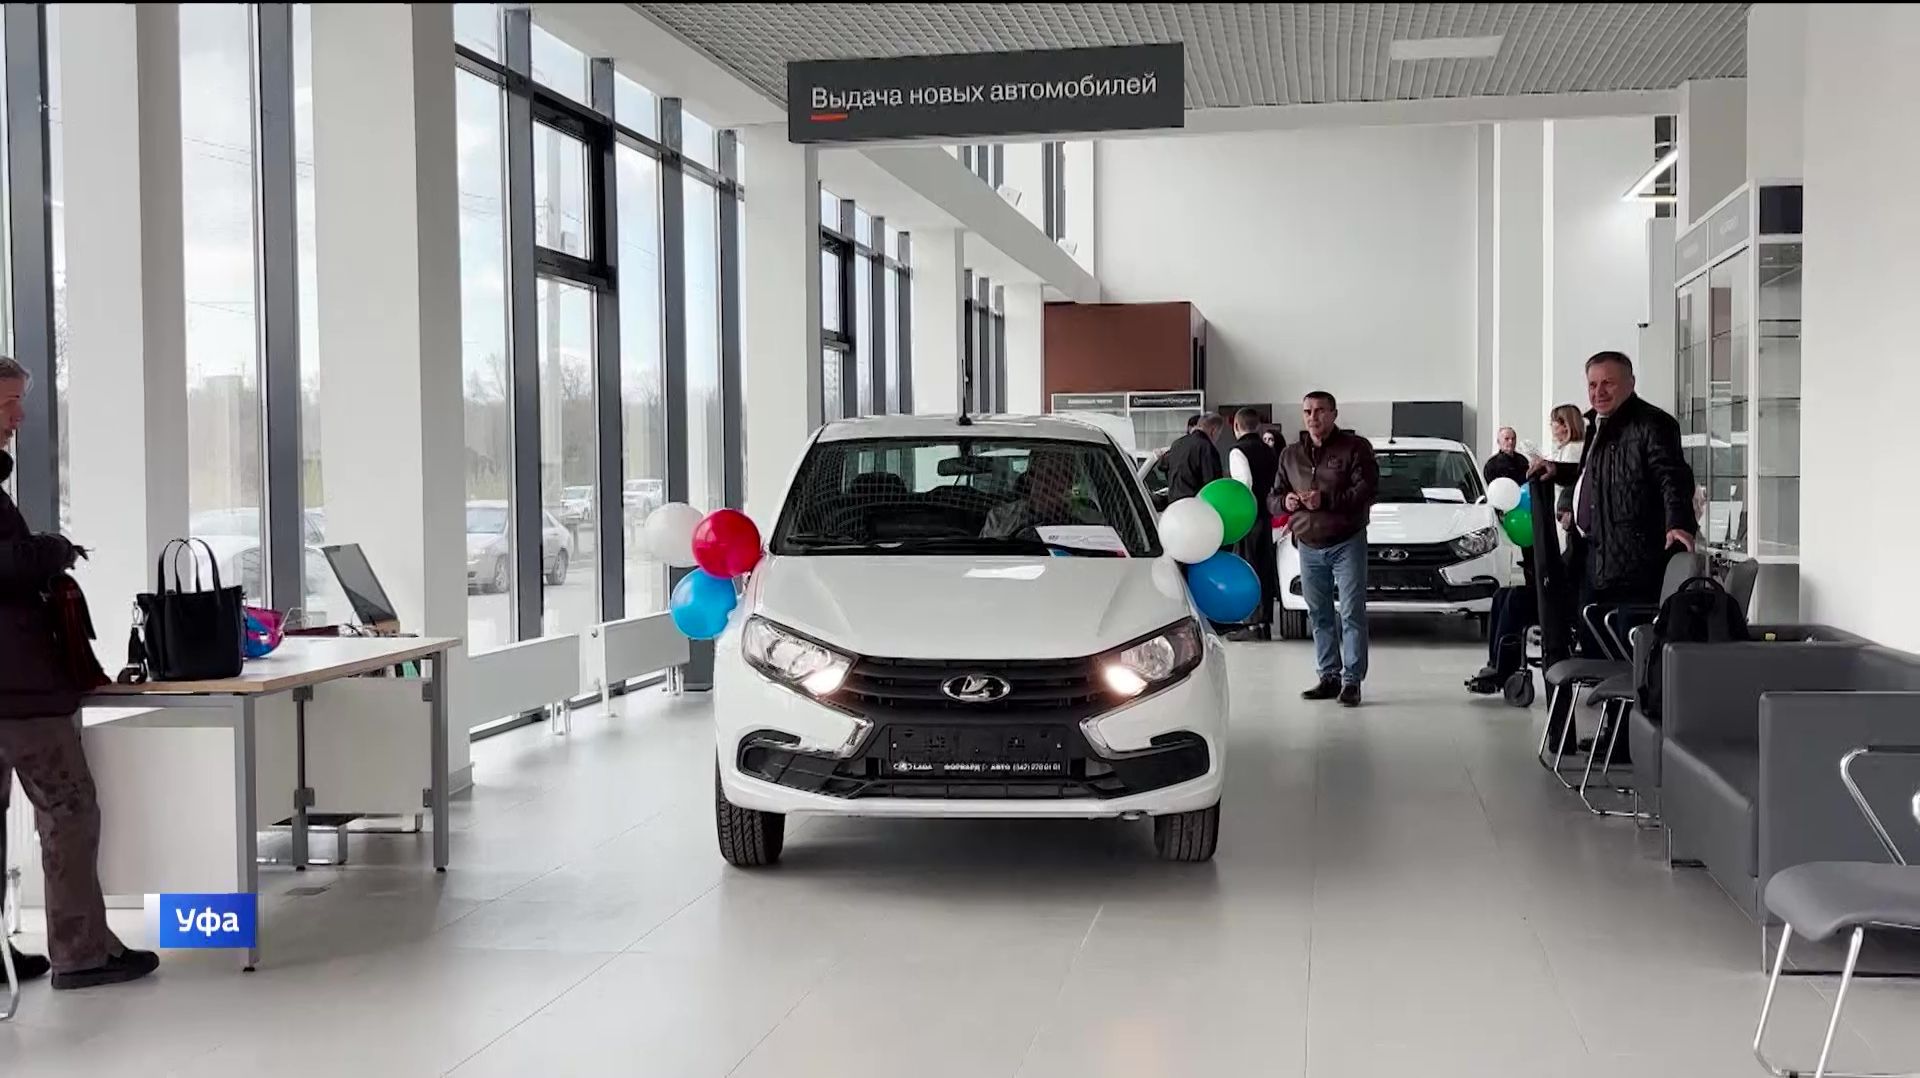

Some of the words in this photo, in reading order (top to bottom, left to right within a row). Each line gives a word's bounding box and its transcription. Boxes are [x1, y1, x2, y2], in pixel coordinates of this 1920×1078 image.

[811, 85, 903, 111] Выдача
[909, 81, 984, 105] новых
[990, 72, 1157, 101] автомобилей
